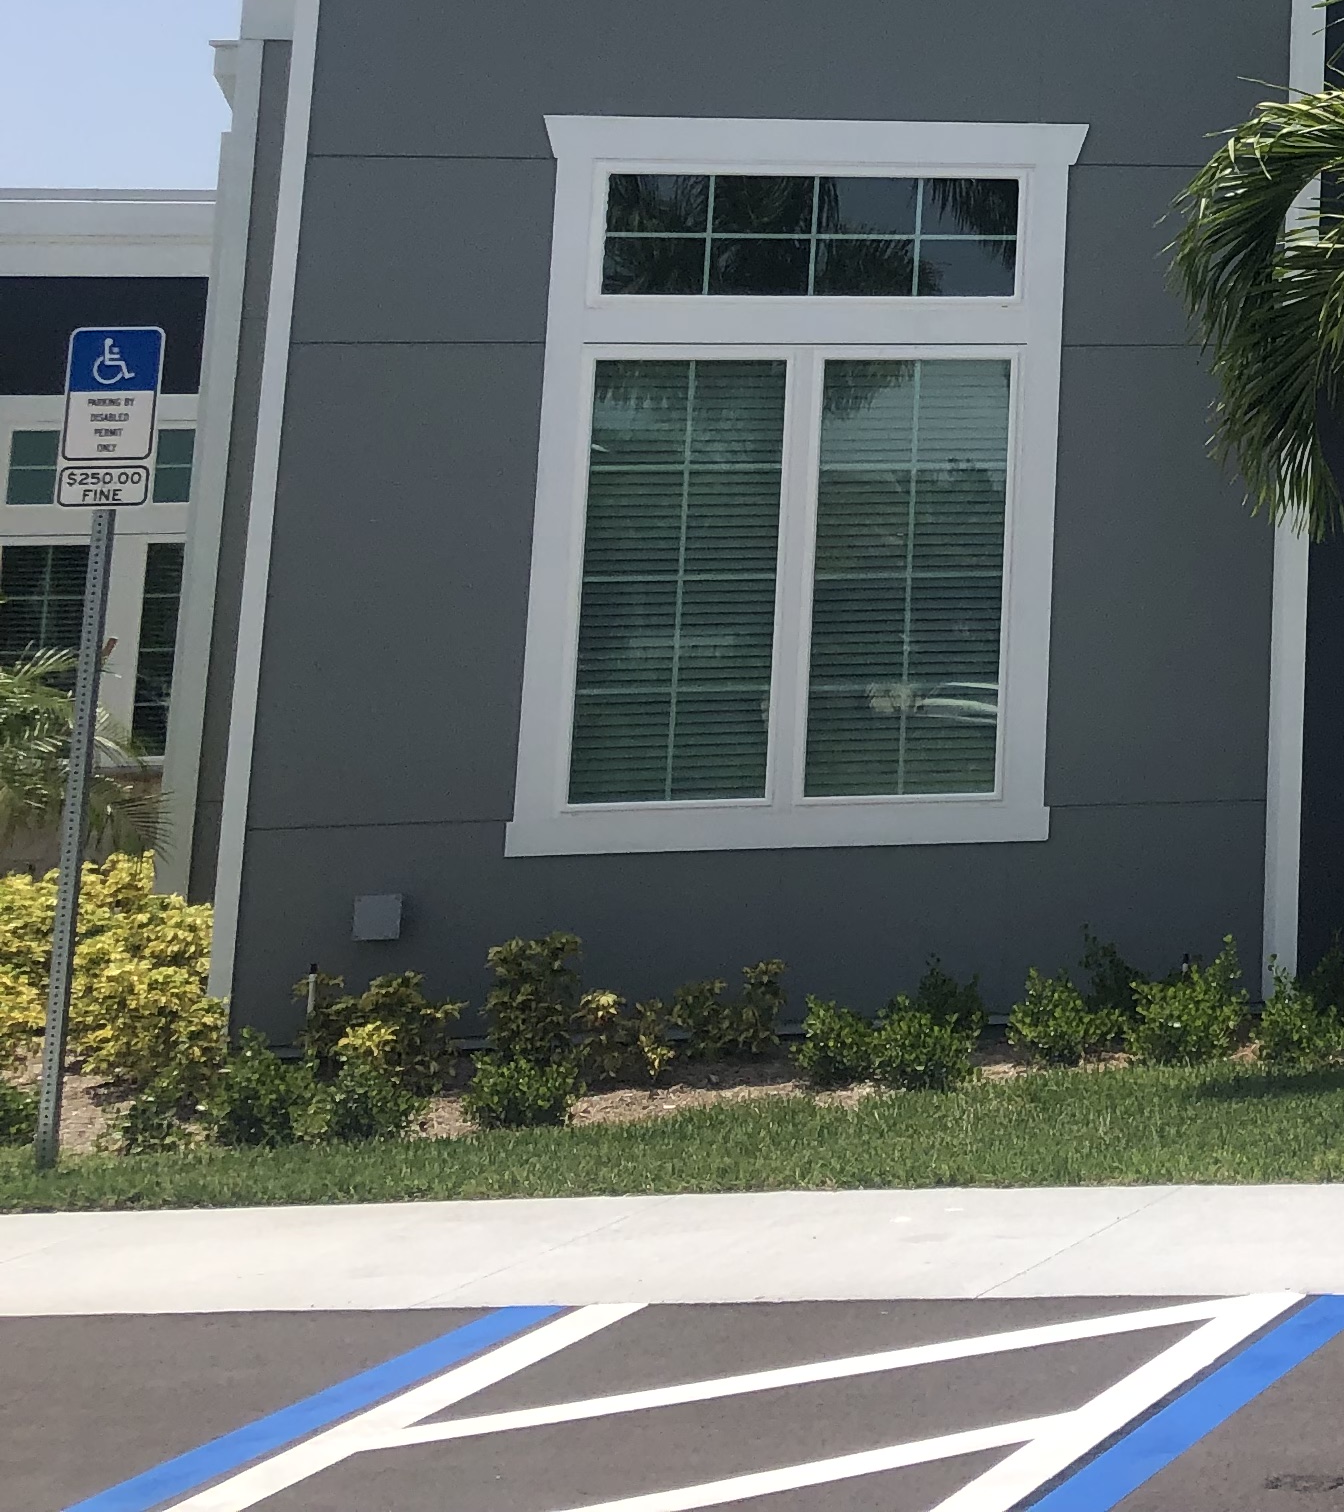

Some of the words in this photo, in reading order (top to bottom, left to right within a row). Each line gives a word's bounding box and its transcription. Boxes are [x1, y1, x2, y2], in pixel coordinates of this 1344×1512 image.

[87, 398, 122, 406] PARKING
[124, 397, 134, 406] BY
[90, 413, 130, 422] DISABLED
[94, 428, 124, 436] PERMIT
[96, 443, 118, 452] ONLY
[66, 471, 142, 487] $250.00
[81, 488, 123, 502] FINE
